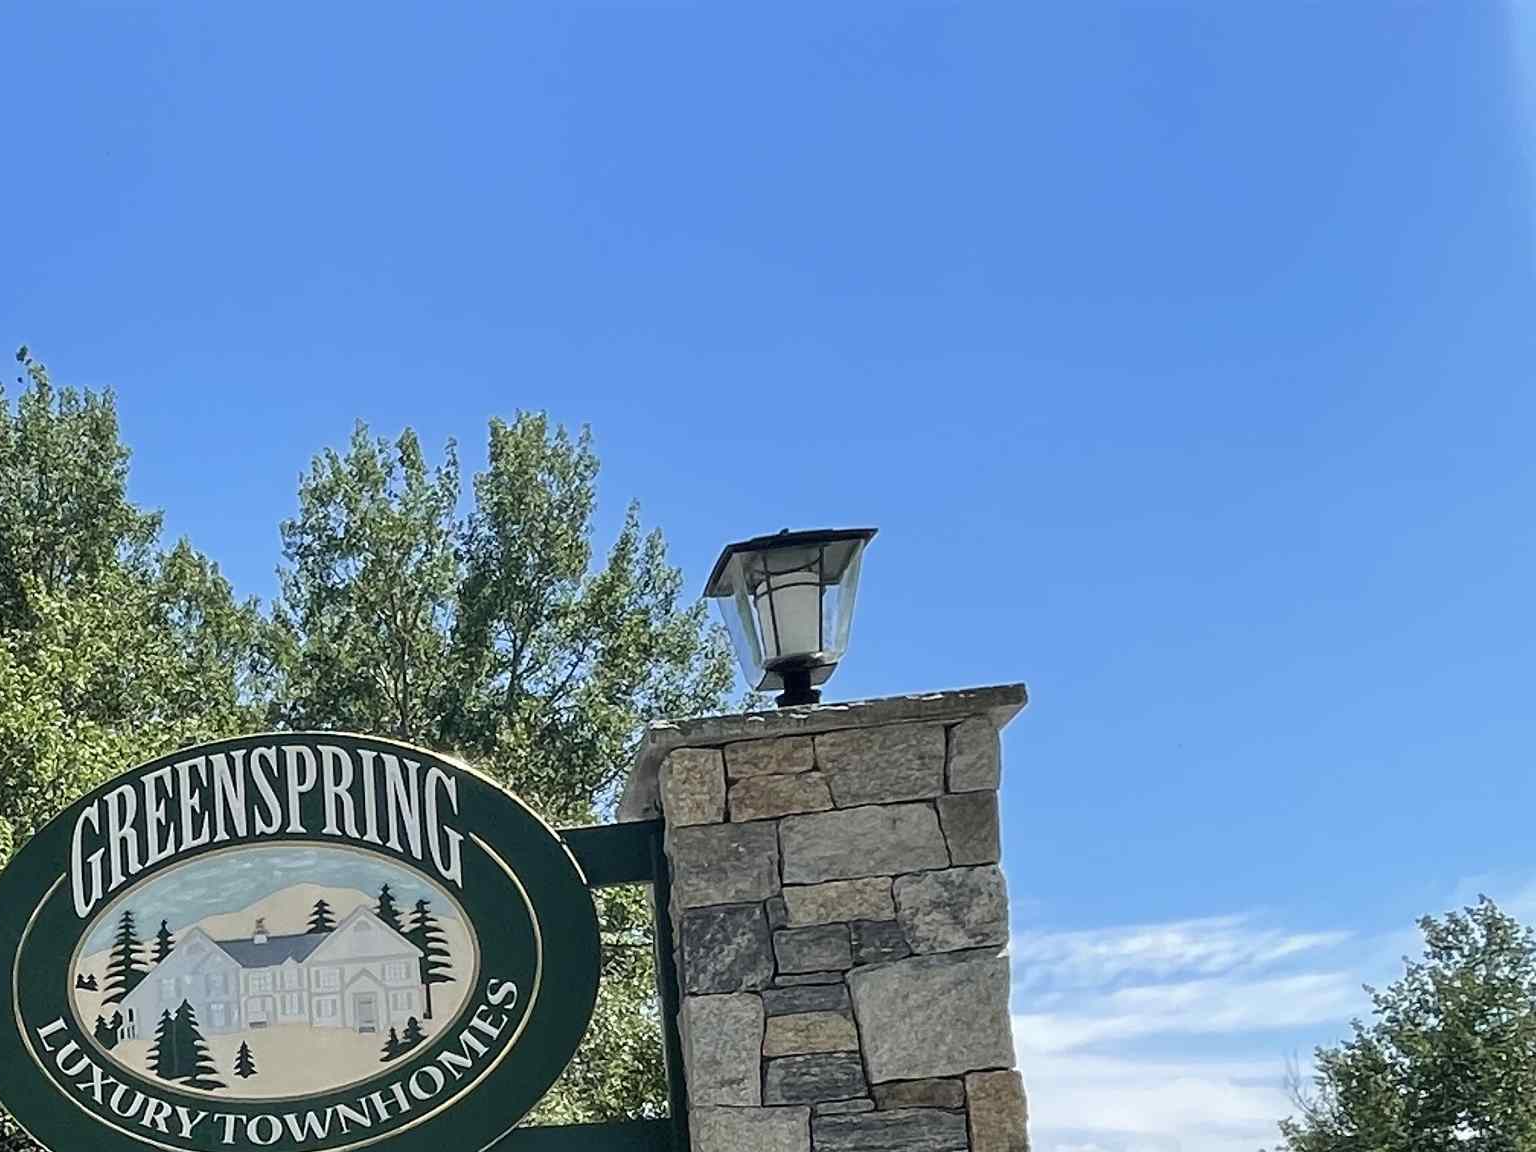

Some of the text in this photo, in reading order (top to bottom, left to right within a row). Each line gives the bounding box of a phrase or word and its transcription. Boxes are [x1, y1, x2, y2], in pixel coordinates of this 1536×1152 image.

[70, 745, 464, 918] GREENSPRING
[36, 977, 518, 1145] LUXURY TOWNHOMES
